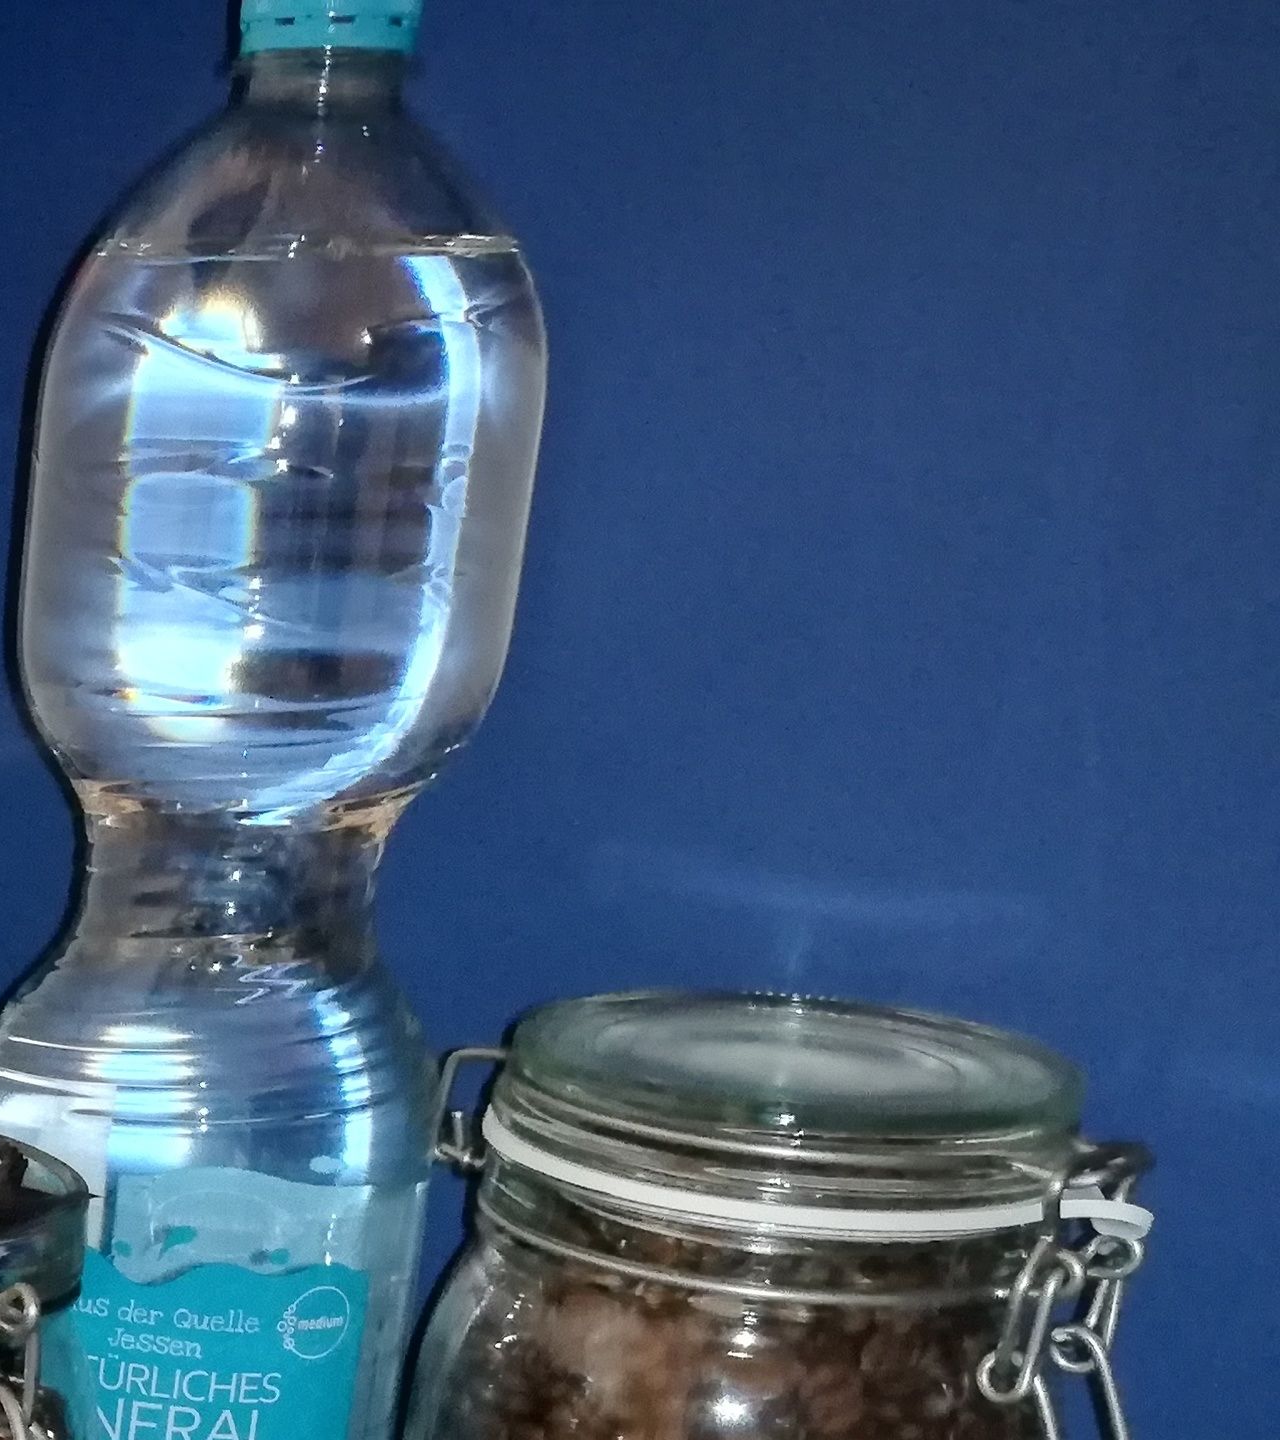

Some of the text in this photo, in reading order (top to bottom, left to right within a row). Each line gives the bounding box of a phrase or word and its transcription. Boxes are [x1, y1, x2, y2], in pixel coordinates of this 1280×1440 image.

[116, 1299, 164, 1326] der
[172, 1307, 260, 1334] Quelle
[297, 1314, 344, 1331] medium
[107, 1326, 203, 1359] Jessen
[87, 1352, 282, 1404] ÜRLICHES
